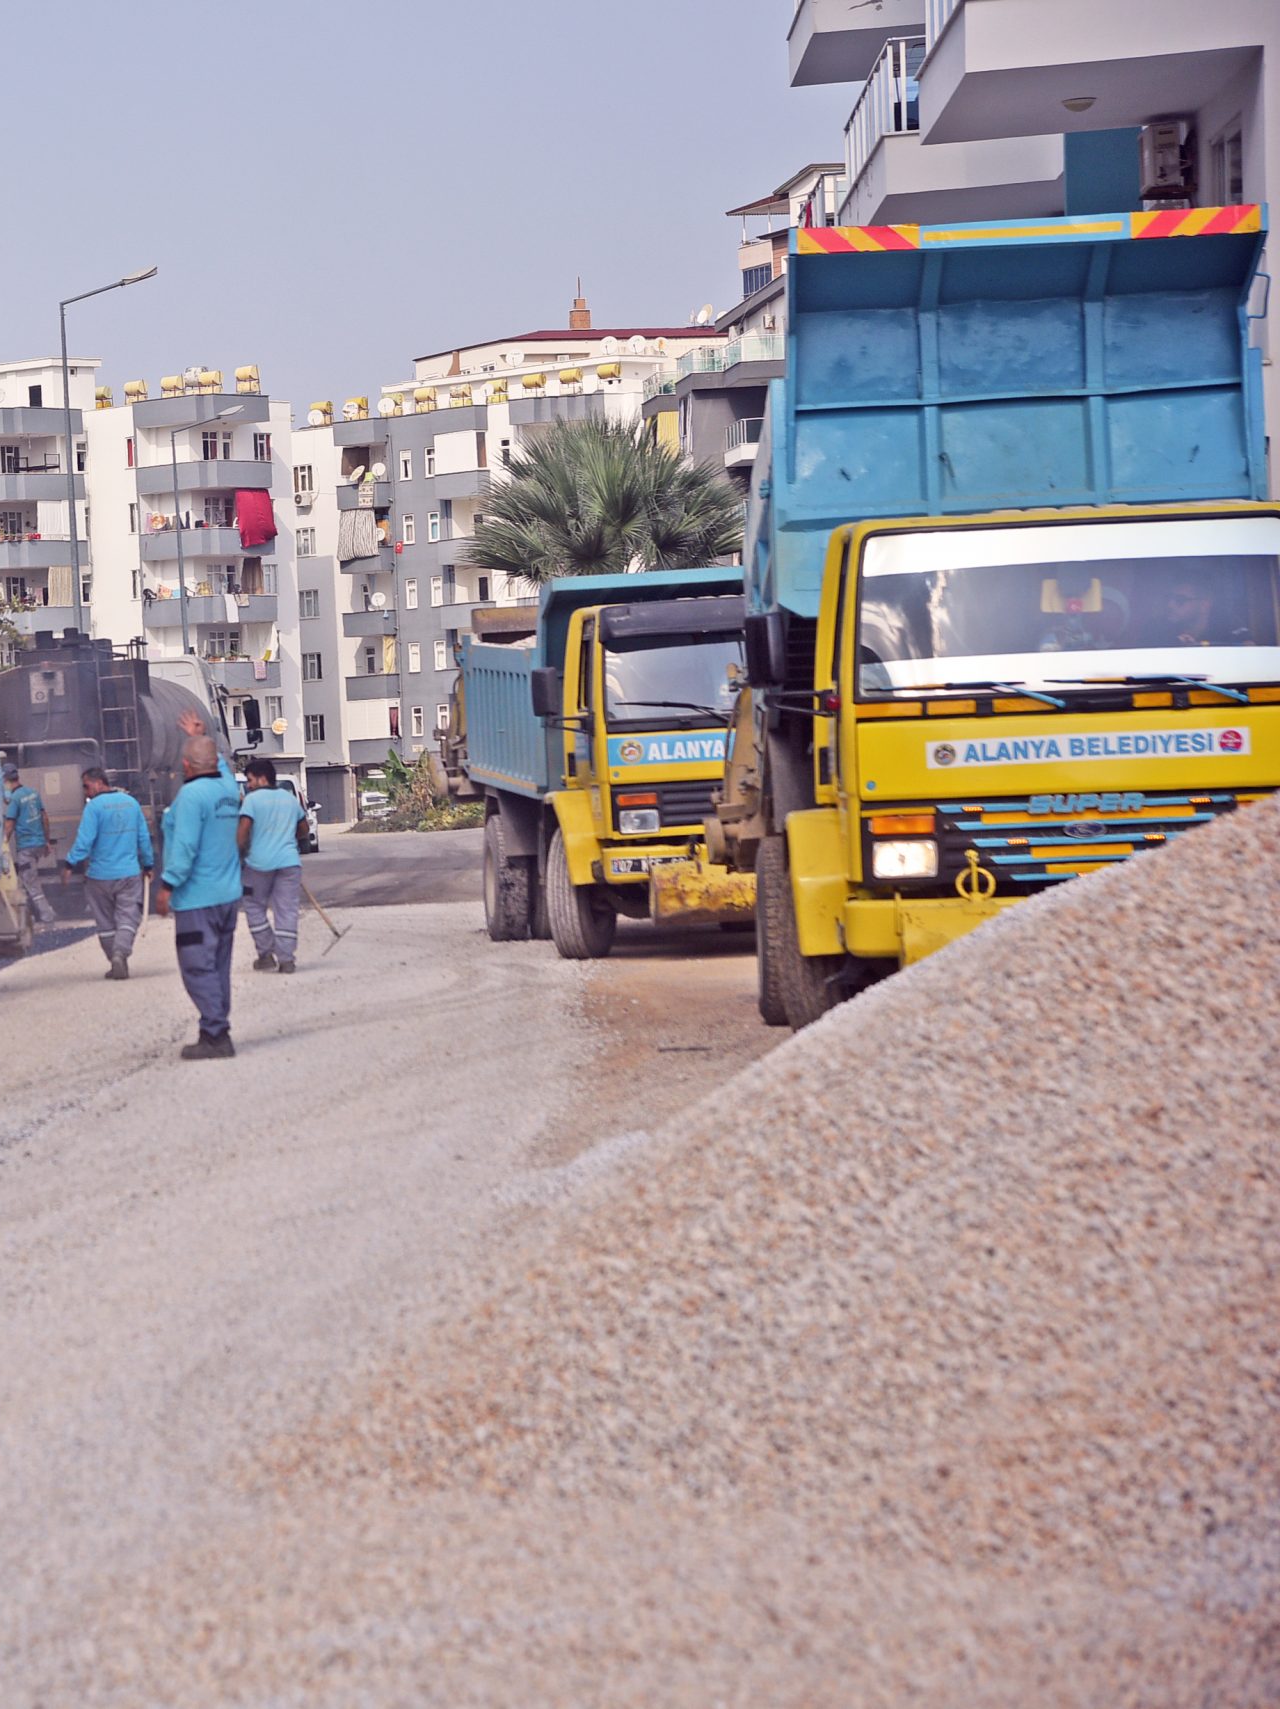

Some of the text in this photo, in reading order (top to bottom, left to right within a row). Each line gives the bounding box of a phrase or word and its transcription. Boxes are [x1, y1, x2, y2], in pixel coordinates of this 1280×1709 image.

[648, 739, 726, 761] ALANYA
[964, 739, 1061, 763] ALANYA
[1069, 732, 1213, 757] BELEDİYESİ
[1027, 792, 1145, 815] SUPER
